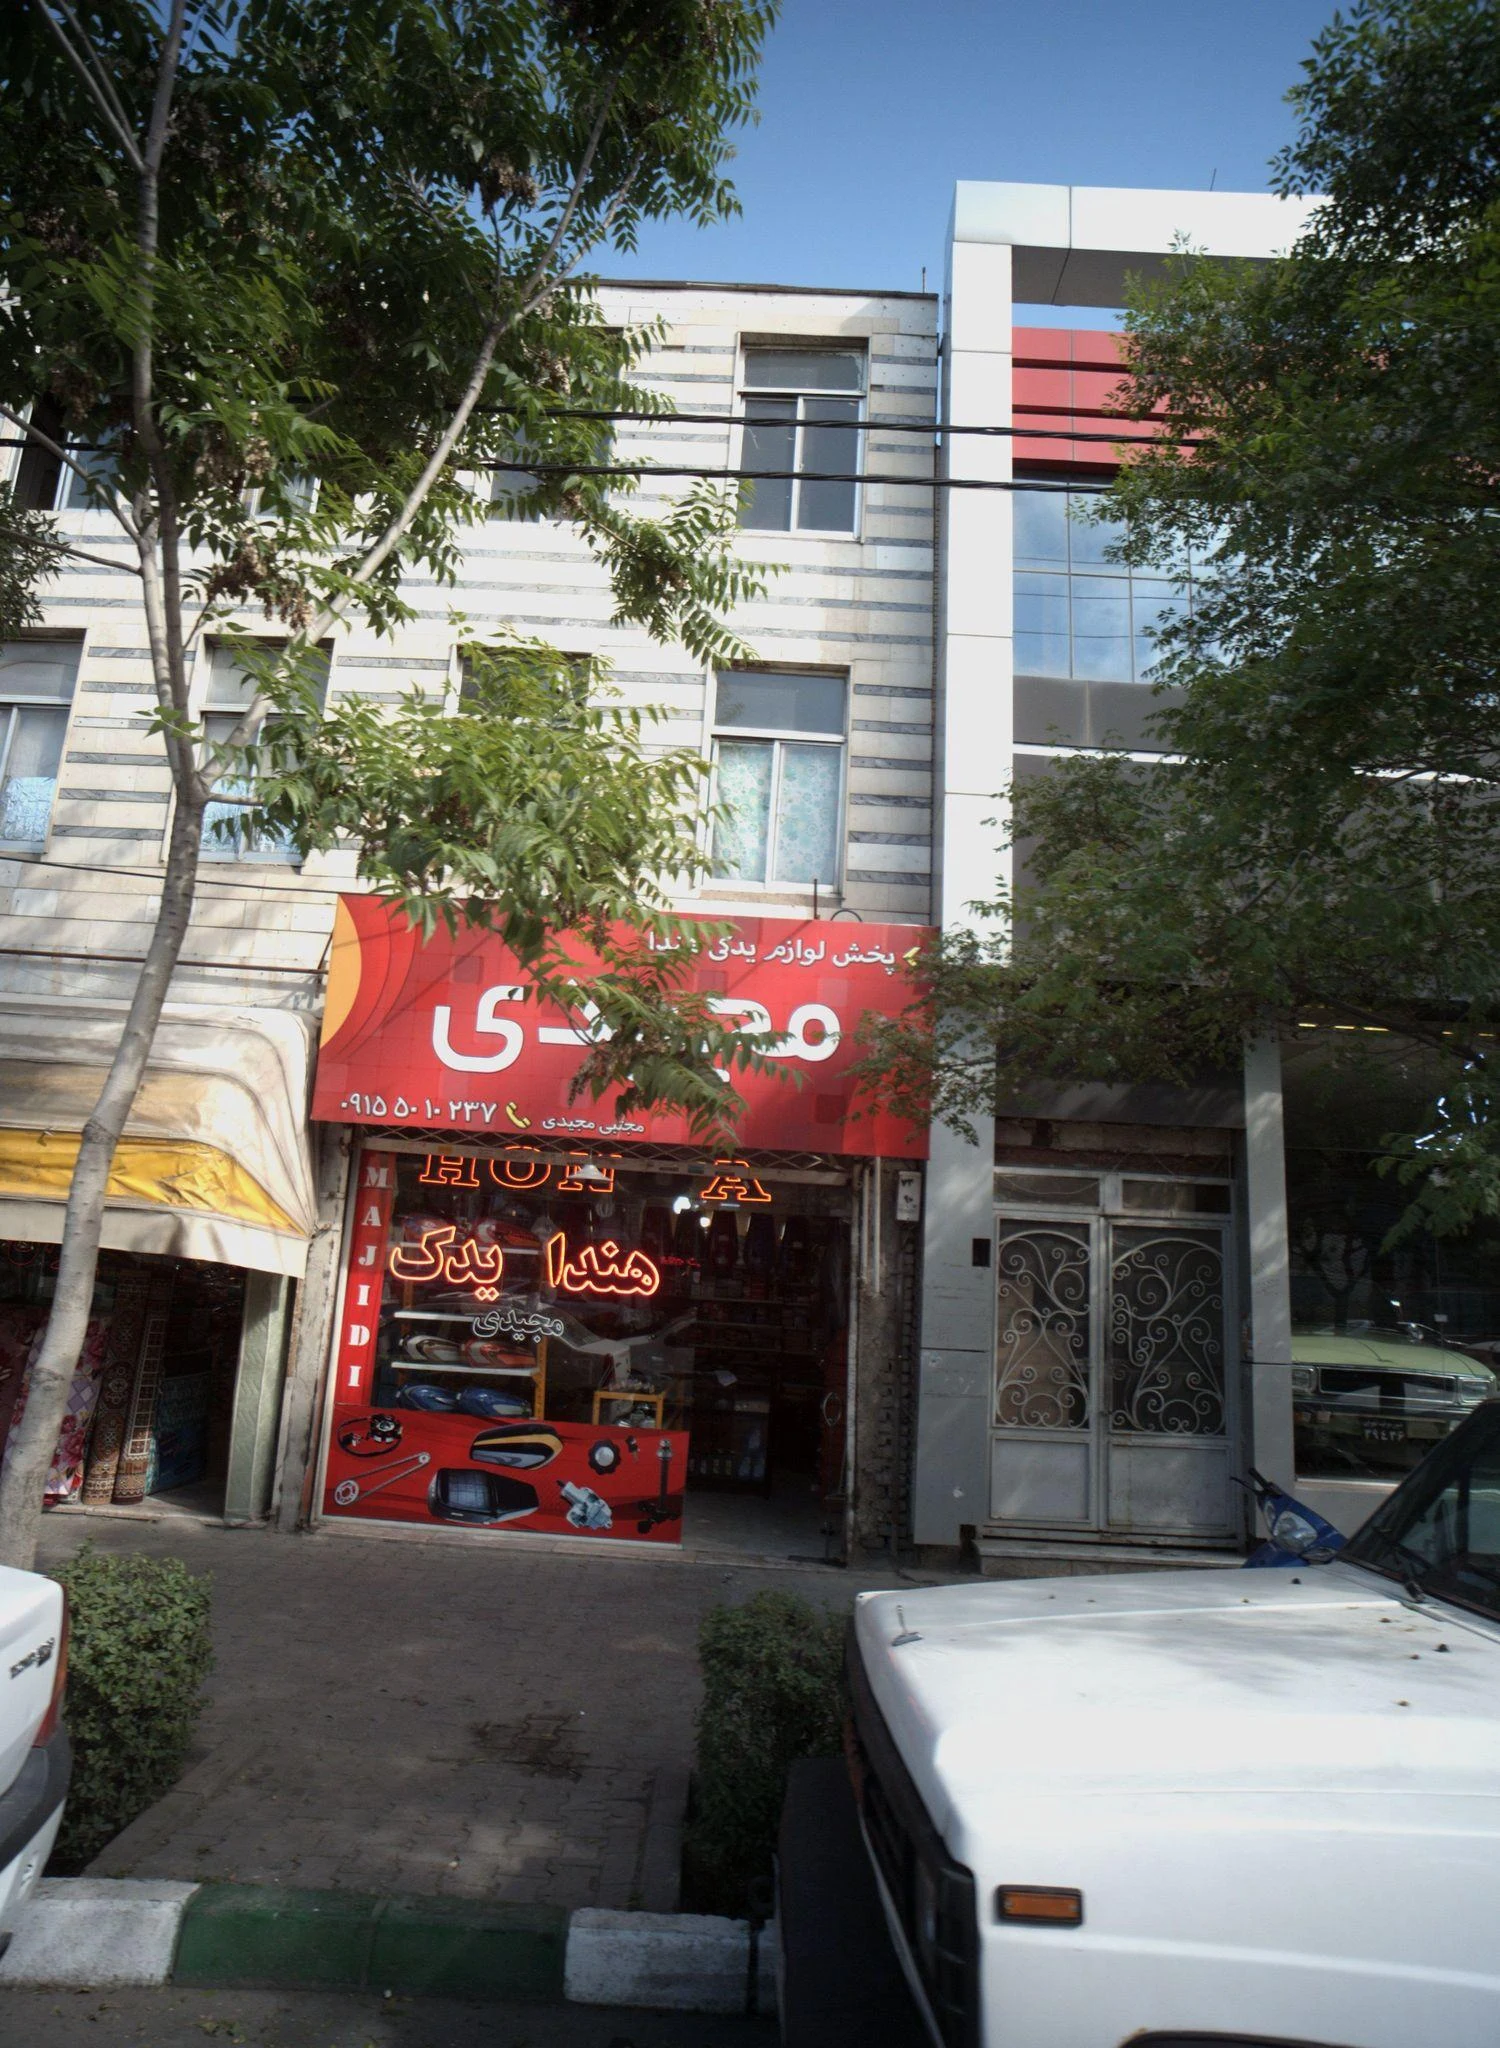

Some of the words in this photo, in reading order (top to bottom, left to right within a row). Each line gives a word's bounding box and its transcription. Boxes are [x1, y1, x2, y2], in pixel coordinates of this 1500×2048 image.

[708, 935, 756, 963] یدکی
[763, 939, 826, 966] لوازم
[832, 943, 896, 976] پخش
[432, 976, 842, 1083] مجدی
[542, 1113, 596, 1131] مجیدی
[347, 1166, 389, 1387] MAJIDI
[389, 1225, 504, 1302] یدک
[547, 1231, 660, 1296] هندا
[472, 1307, 564, 1343] مجیدی
